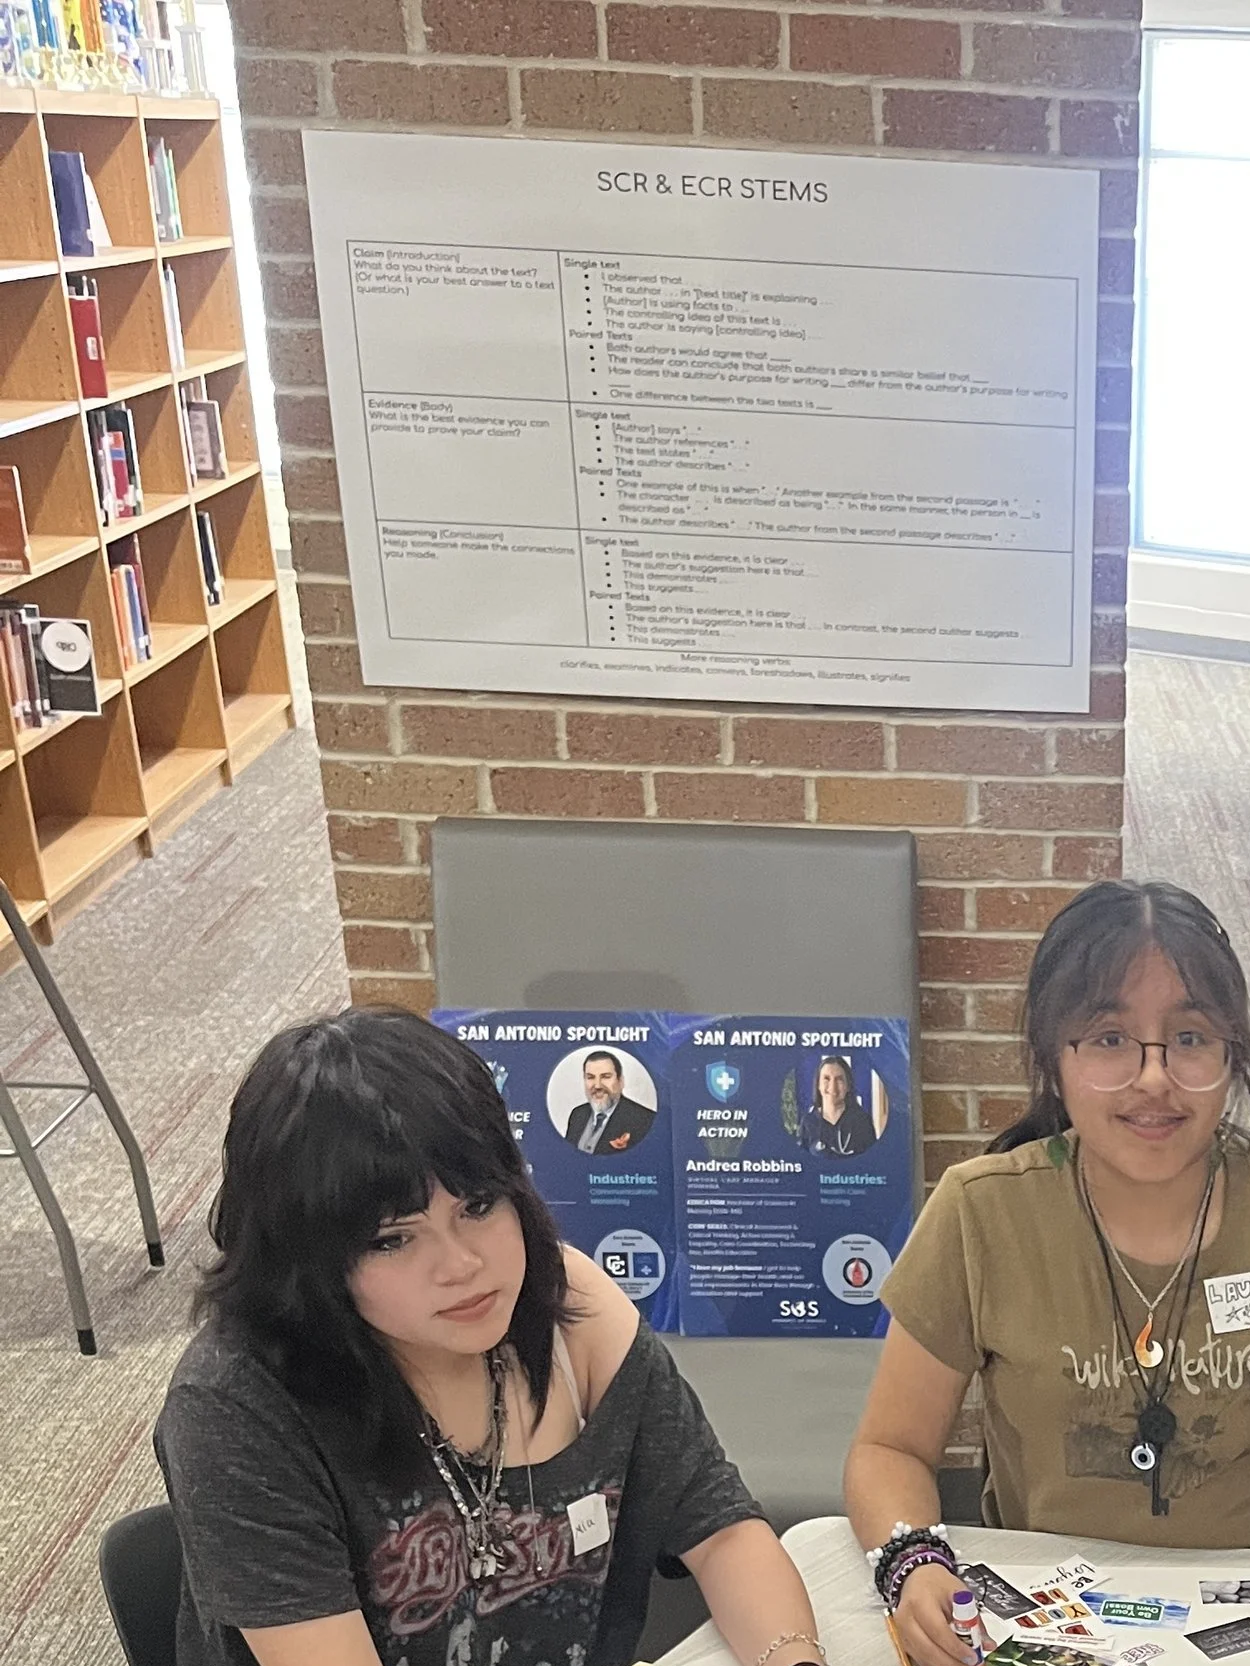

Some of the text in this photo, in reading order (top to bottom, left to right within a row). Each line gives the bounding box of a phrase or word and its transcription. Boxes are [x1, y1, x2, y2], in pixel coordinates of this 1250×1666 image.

[597, 171, 829, 204] SCR & ECR STEMS
[353, 258, 537, 277] What do you think about the text?
[563, 257, 620, 270] Single text
[602, 306, 780, 326] The controlling idea of this text is
[568, 328, 632, 341] Paired Texts
[457, 1026, 650, 1042] SAN ANTONIO SPOTLIGHT
[693, 1031, 883, 1048] SAN ANTONIO SPOTLIGHT
[697, 1109, 748, 1121] HERO IN
[698, 1126, 748, 1138] ACTION
[686, 1159, 802, 1173] Andrea Robbins
[589, 1173, 658, 1185] Industries:
[820, 1173, 887, 1186] Industries:
